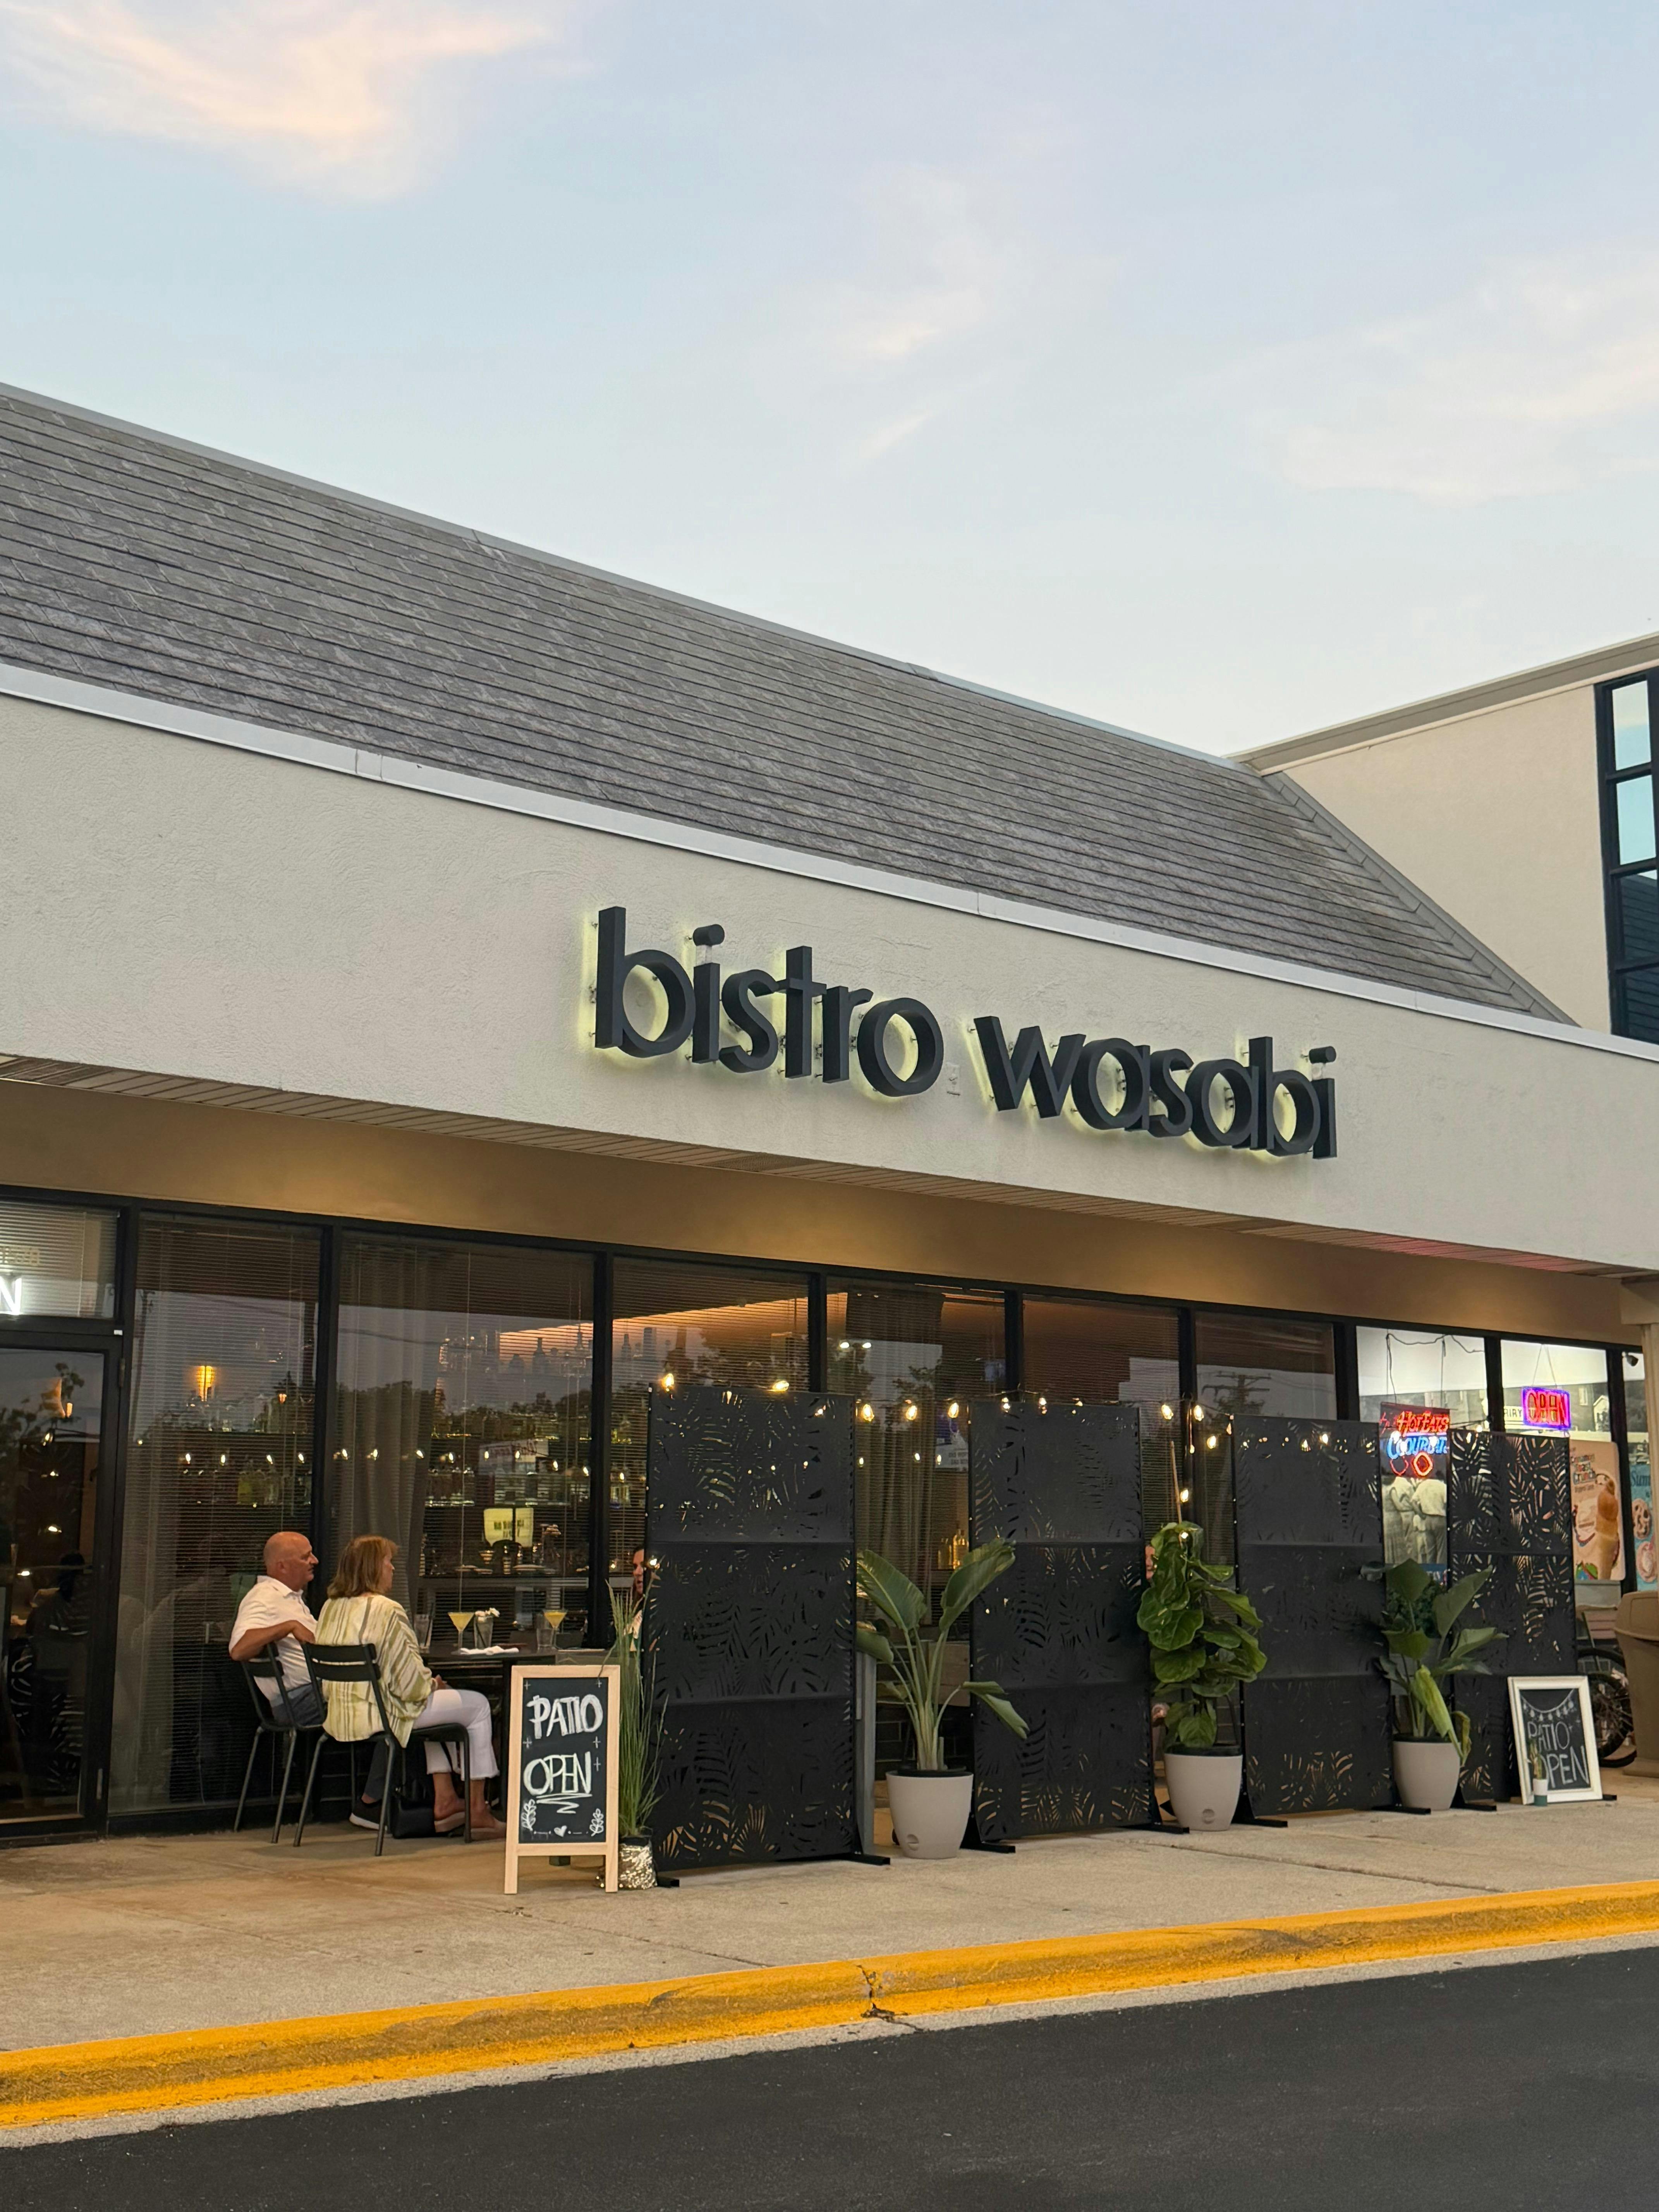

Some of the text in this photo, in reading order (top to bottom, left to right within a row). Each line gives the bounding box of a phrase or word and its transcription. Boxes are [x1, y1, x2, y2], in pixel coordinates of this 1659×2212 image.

[594, 905, 1337, 1160] bistro wasabi
[1525, 1389, 1569, 1426] OPEN
[526, 1693, 603, 1739] PATIO
[1527, 1721, 1570, 1752] PATIO
[524, 1752, 591, 1796] OPEN
